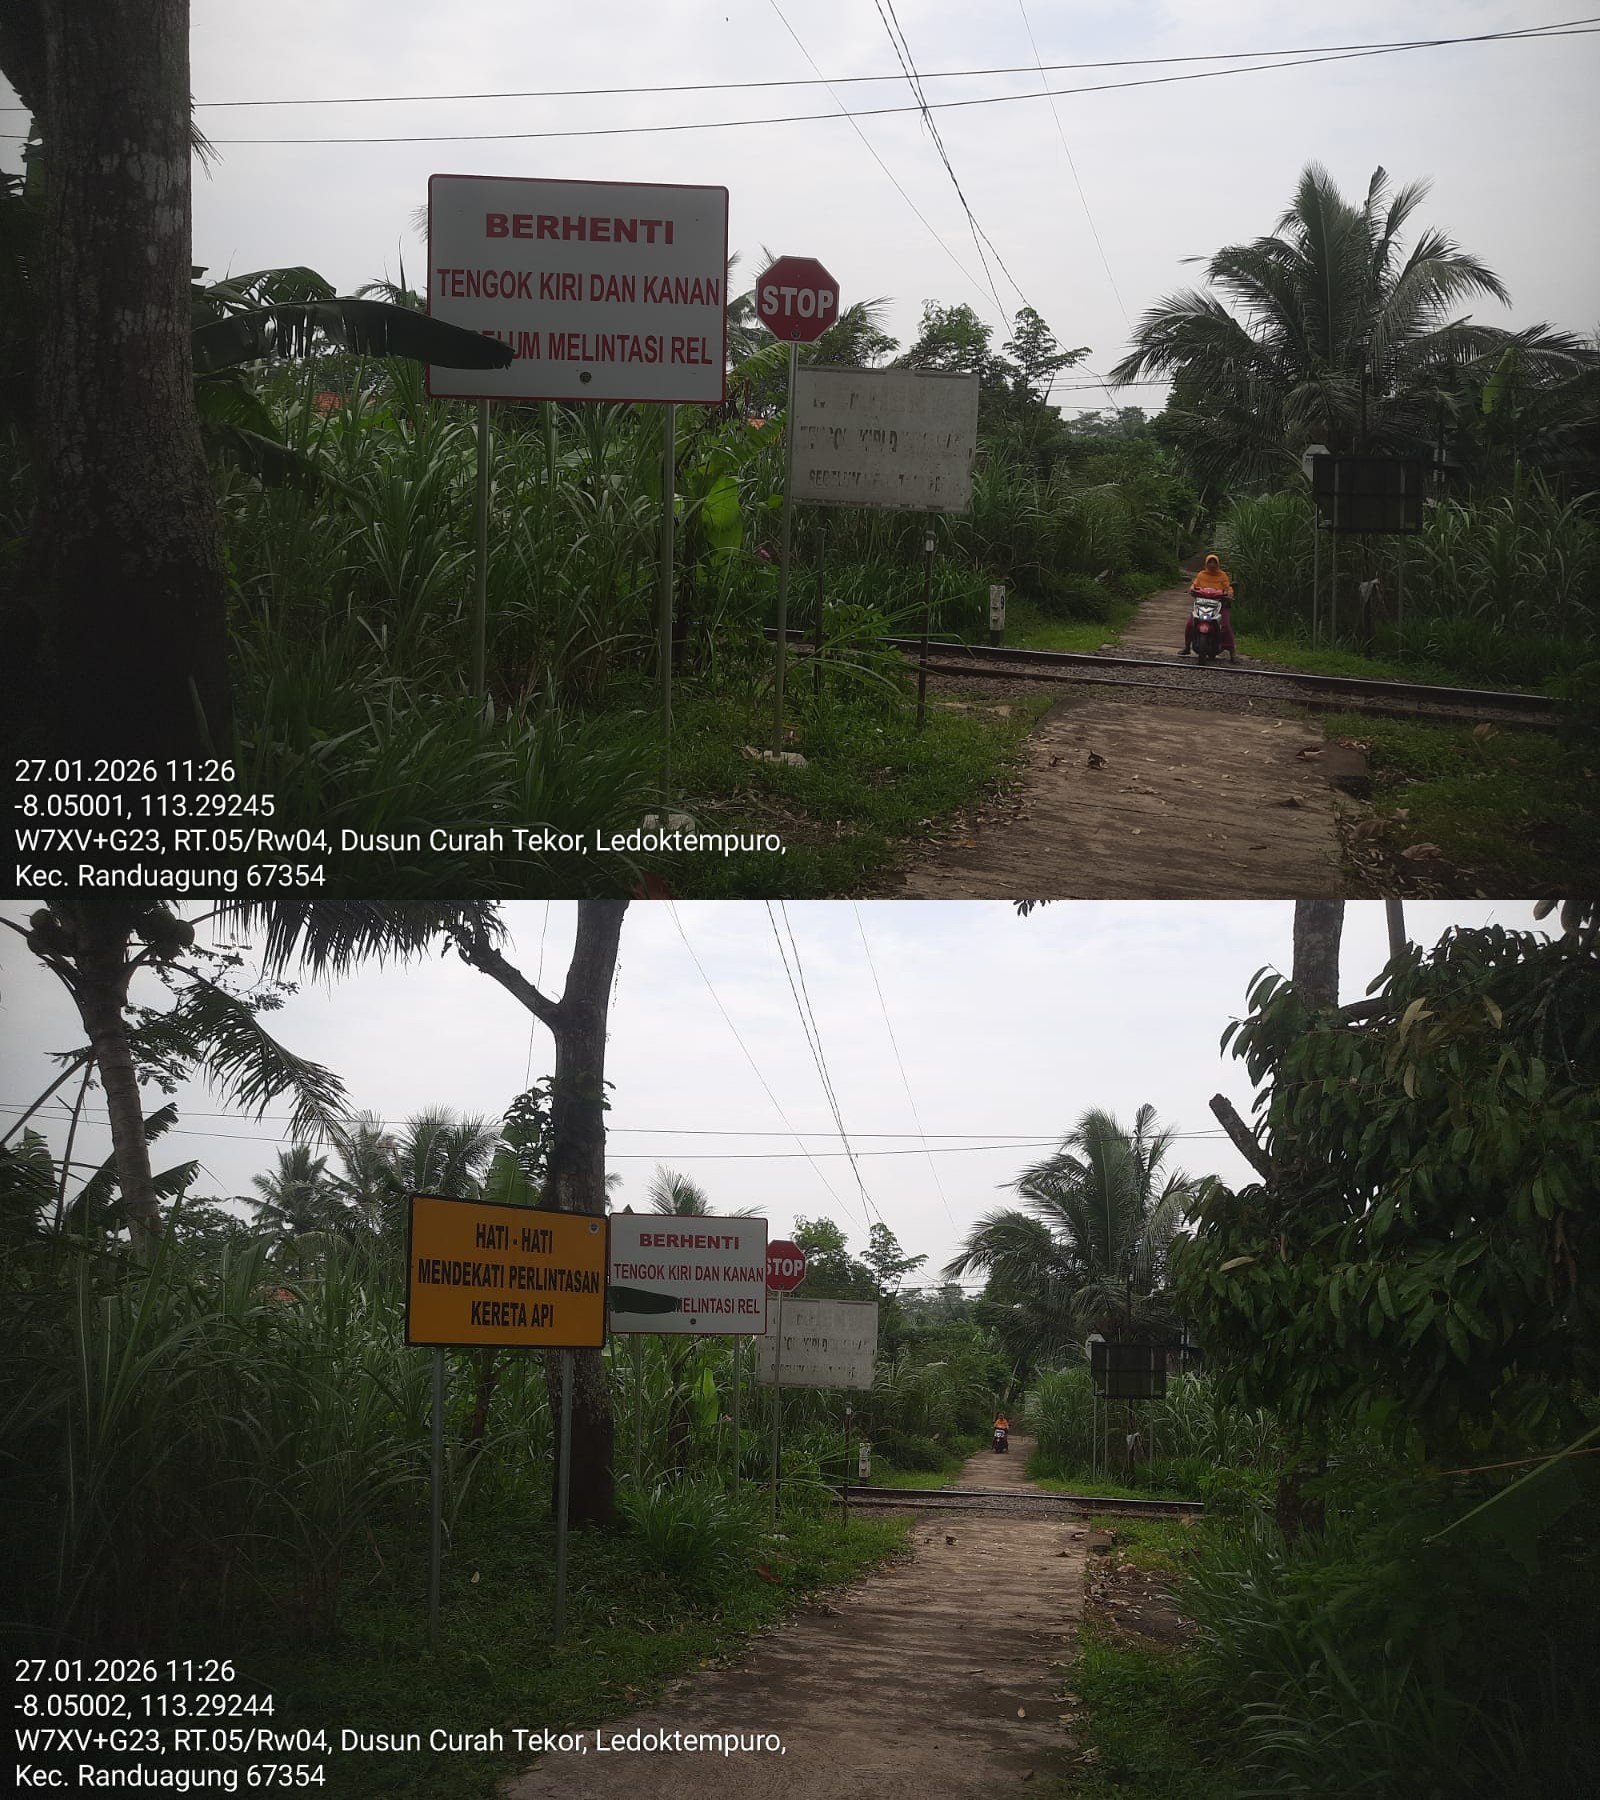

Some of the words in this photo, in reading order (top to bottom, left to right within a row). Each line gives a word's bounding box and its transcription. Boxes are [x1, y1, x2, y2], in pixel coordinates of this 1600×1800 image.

[486, 213, 674, 244] BERHENTI
[437, 268, 532, 299] TENGOK
[540, 272, 582, 301] KIRI
[590, 273, 635, 302] DAN
[644, 275, 720, 306] KANAN
[762, 285, 834, 319] STOP
[548, 332, 663, 363] MELINTASI
[671, 336, 713, 365] REL
[476, 1223, 509, 1250] HATI
[522, 1228, 553, 1254] HATI
[639, 1233, 740, 1250] BERHENTI
[418, 1258, 504, 1288] MENDEKATI
[509, 1265, 599, 1294] PERLINTASAN
[614, 1263, 665, 1280] TENGOK
[668, 1265, 692, 1281] KIRI
[696, 1266, 720, 1282] DAN
[723, 1266, 764, 1283] KANAN
[471, 1301, 527, 1328] KERETA
[531, 1304, 553, 1328] API
[738, 1299, 760, 1314] REL
